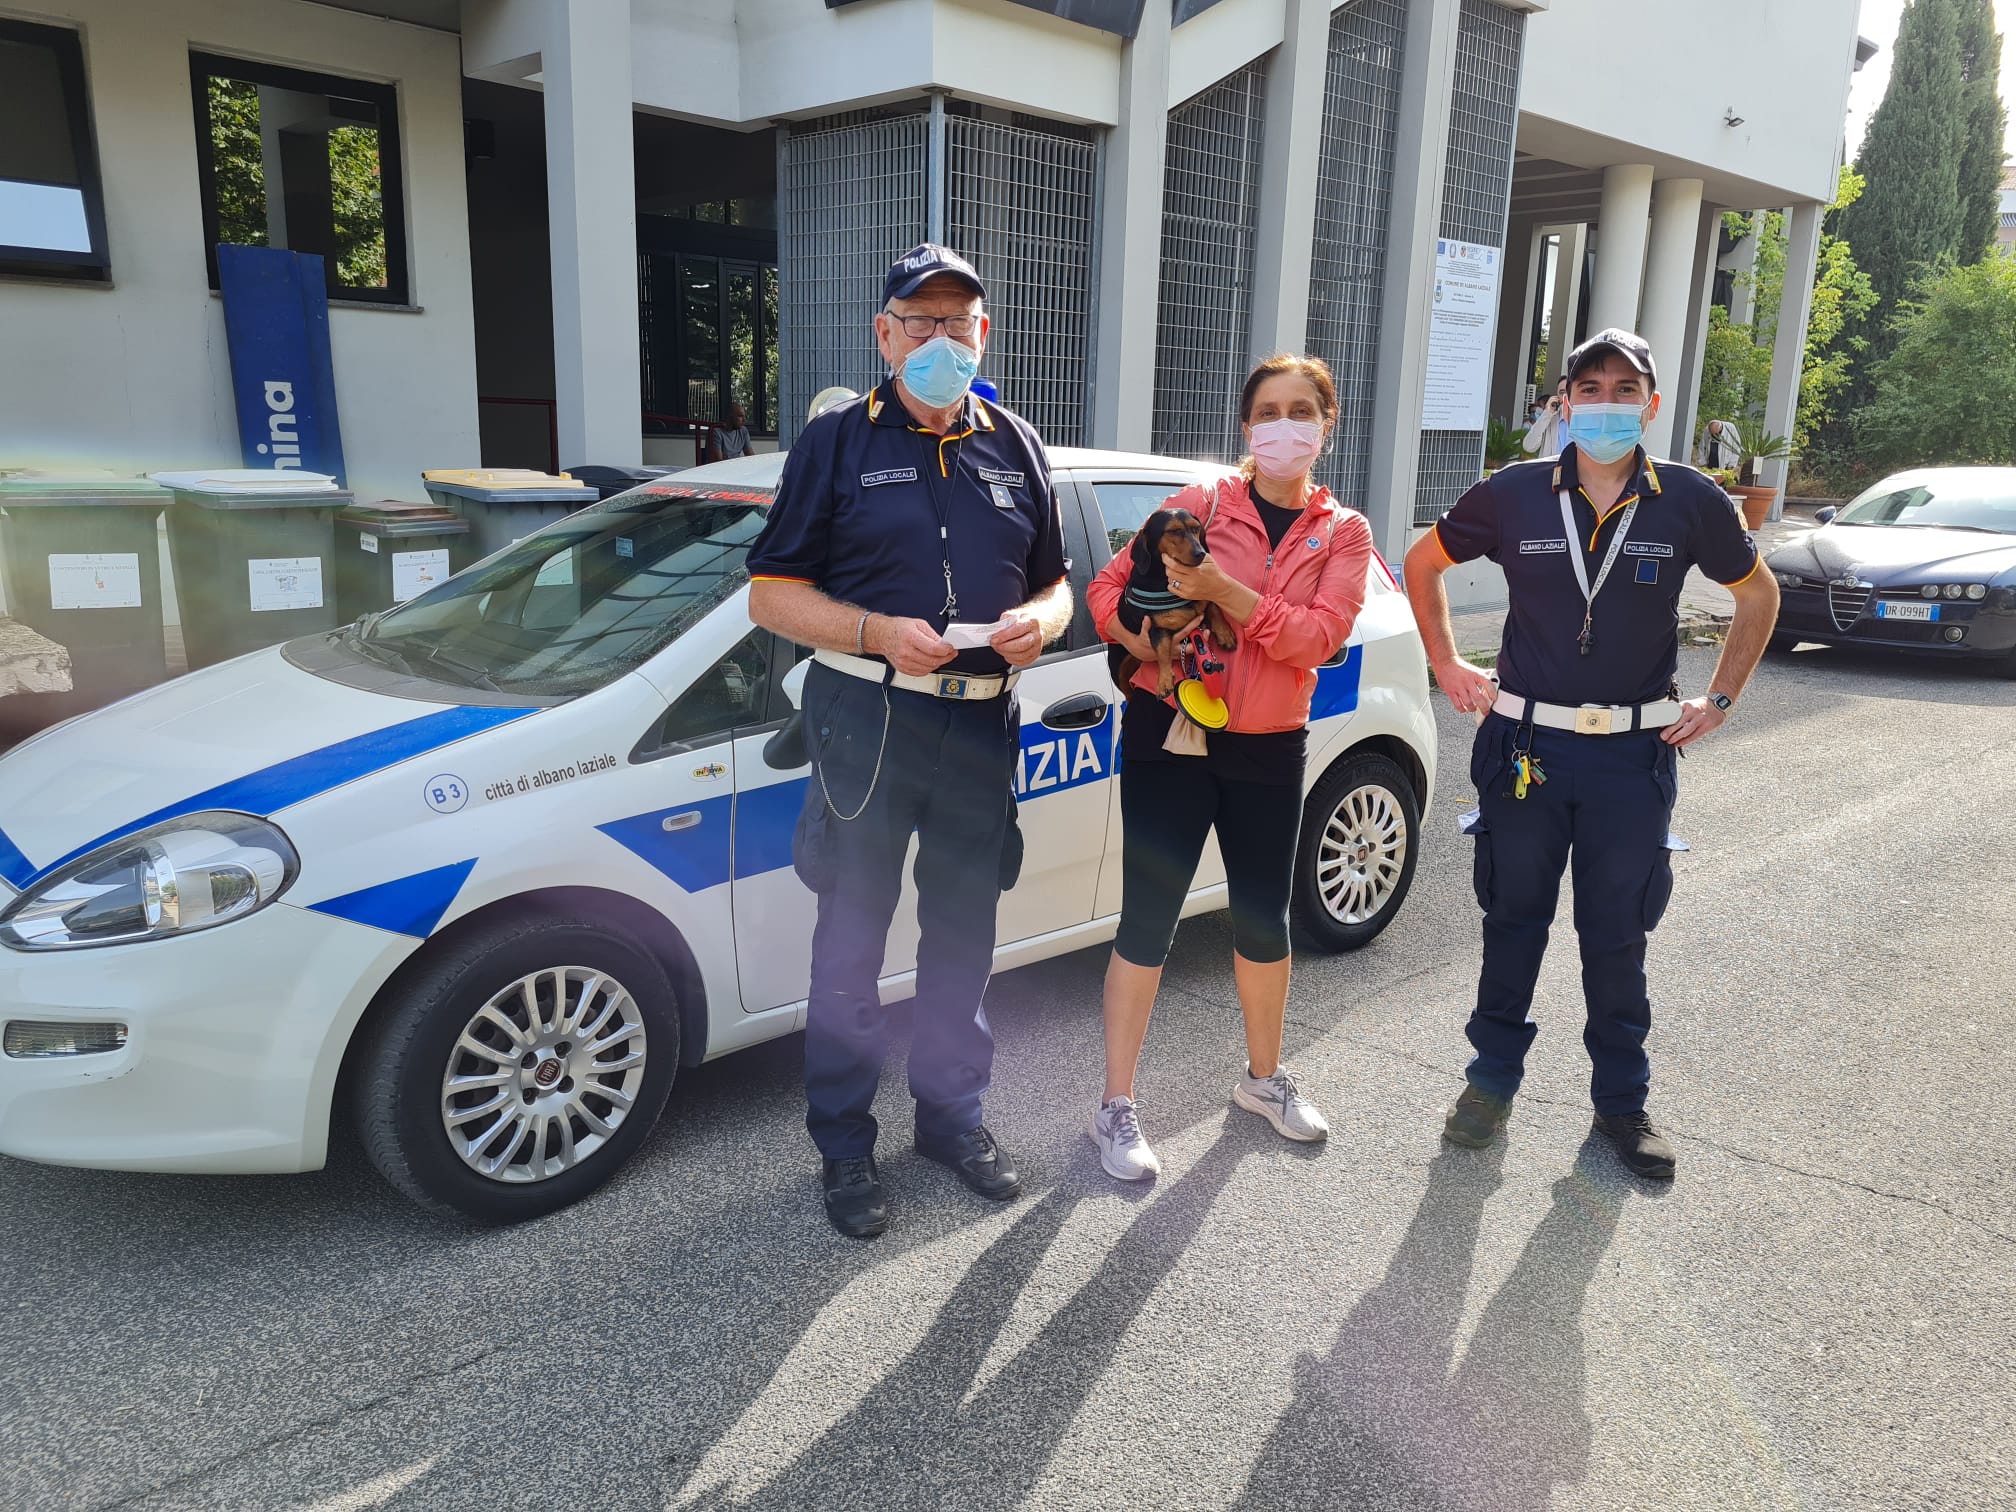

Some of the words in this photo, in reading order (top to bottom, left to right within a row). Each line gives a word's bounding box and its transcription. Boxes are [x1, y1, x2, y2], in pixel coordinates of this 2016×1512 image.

[904, 250, 938, 272] POLIZIA
[864, 474, 888, 484] POLIZIA
[889, 472, 914, 480] LOCALE
[1000, 474, 1024, 484] LAZIALE
[1522, 543, 1542, 551] ALBANO
[1542, 542, 1565, 550] LAZIALE
[1650, 546, 1671, 554] LOCALE
[1886, 605, 1899, 616] DR
[1900, 606, 1931, 618] 099HT
[484, 779, 514, 801] città
[517, 774, 530, 792] di
[533, 765, 576, 788] albano
[577, 753, 617, 776] laziale
[431, 787, 447, 804] B
[448, 783, 462, 799] 3
